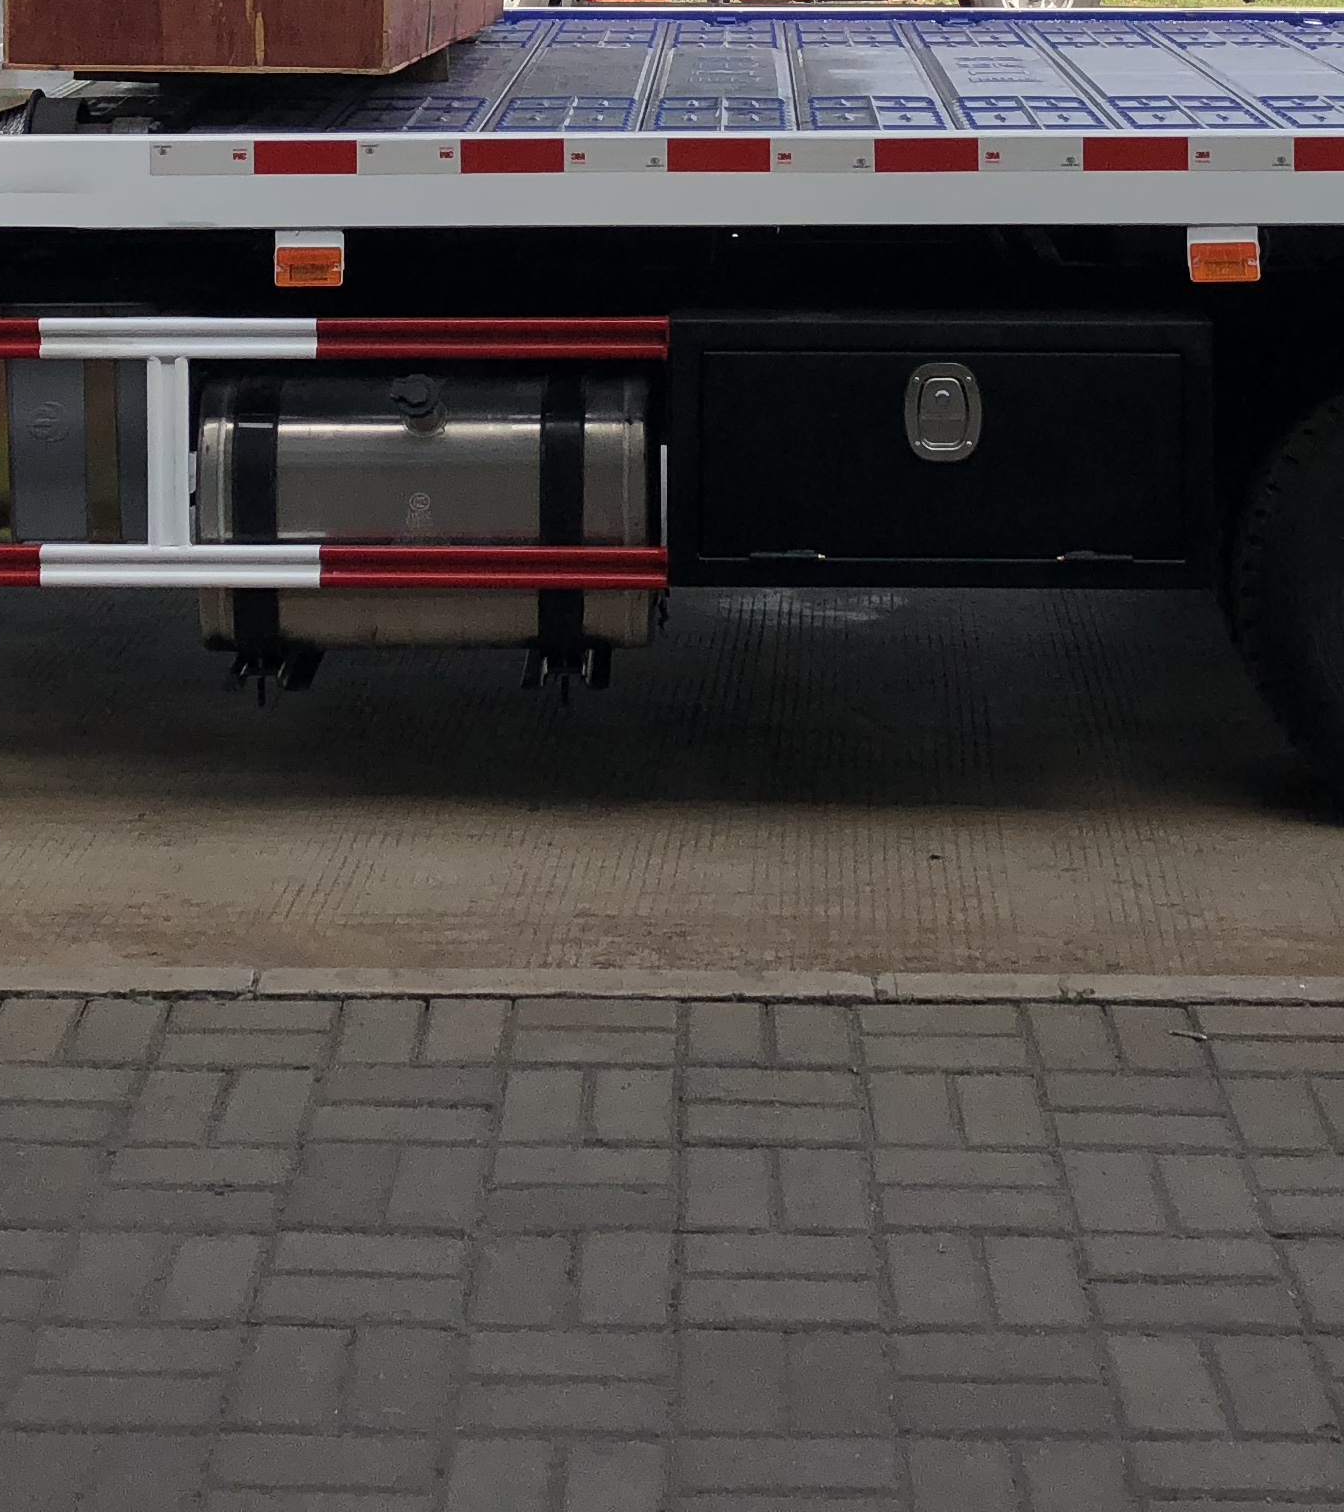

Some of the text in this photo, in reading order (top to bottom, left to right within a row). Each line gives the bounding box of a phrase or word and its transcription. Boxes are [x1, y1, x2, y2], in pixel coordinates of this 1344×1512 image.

[571, 152, 586, 162] 3M
[778, 152, 792, 161] 3M
[986, 152, 1000, 161] 3M
[1196, 151, 1211, 160] 3M
